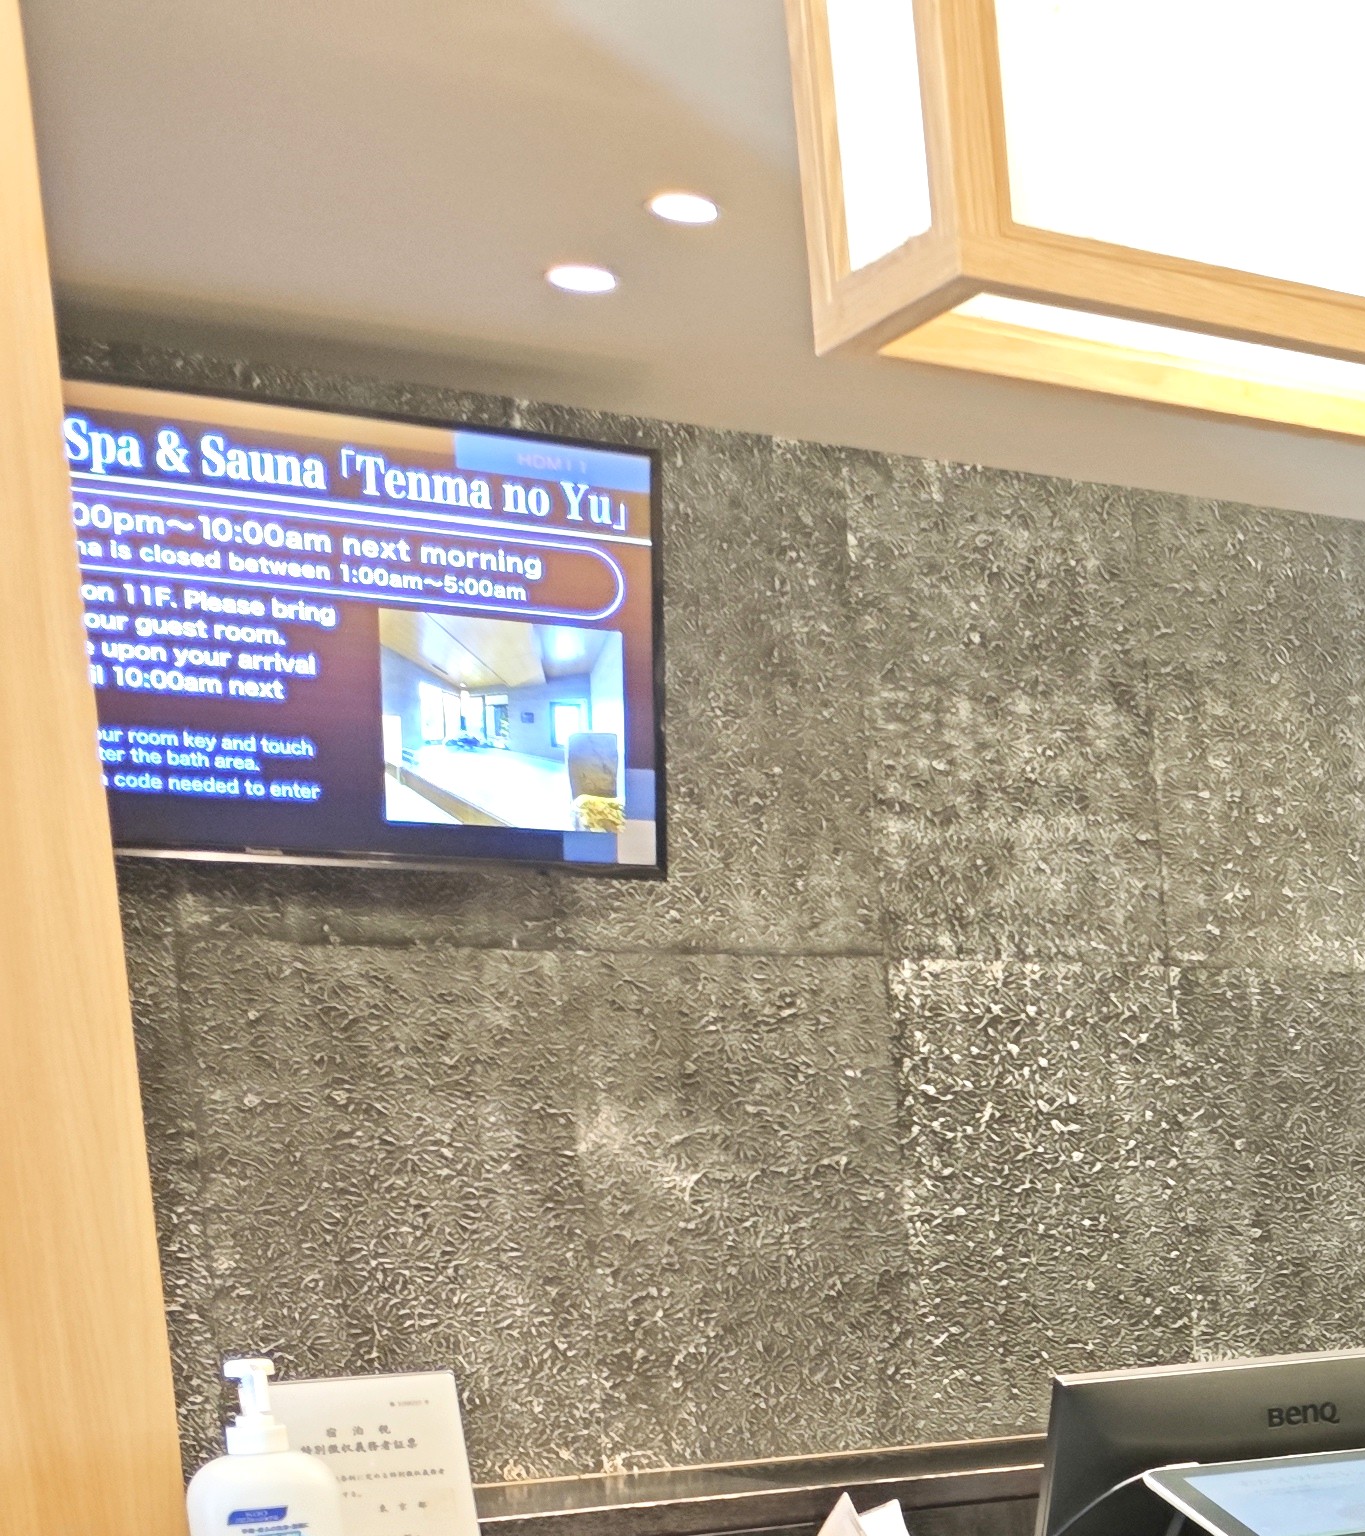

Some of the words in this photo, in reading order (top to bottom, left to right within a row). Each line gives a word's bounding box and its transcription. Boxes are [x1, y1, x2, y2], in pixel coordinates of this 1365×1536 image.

[63, 417, 143, 475] Spa
[155, 429, 190, 474] &
[200, 435, 327, 490] Sauna
[502, 482, 550, 517] no
[110, 540, 132, 560] is
[139, 544, 221, 569] closed
[228, 552, 331, 581] between
[342, 534, 411, 563] next
[420, 544, 542, 580] morning
[81, 584, 115, 603] on
[123, 583, 178, 608] 11F.
[183, 589, 266, 616] Please
[271, 598, 336, 627] bring
[135, 617, 208, 637] guest
[213, 623, 286, 646] room.
[102, 642, 167, 662] upon
[173, 648, 232, 667] your
[238, 652, 317, 675] arrival
[113, 666, 222, 694] 10:00am
[229, 678, 285, 700] next
[128, 731, 178, 746] room
[183, 731, 217, 751] key
[221, 736, 257, 753] and
[261, 737, 314, 756] touch
[130, 748, 162, 764] the
[167, 749, 210, 768] bath
[214, 756, 261, 771] area.
[114, 773, 163, 790] code
[168, 777, 240, 795] needed
[244, 780, 266, 797] to
[270, 784, 321, 800] enter
[1267, 1401, 1341, 1428] BenQ
